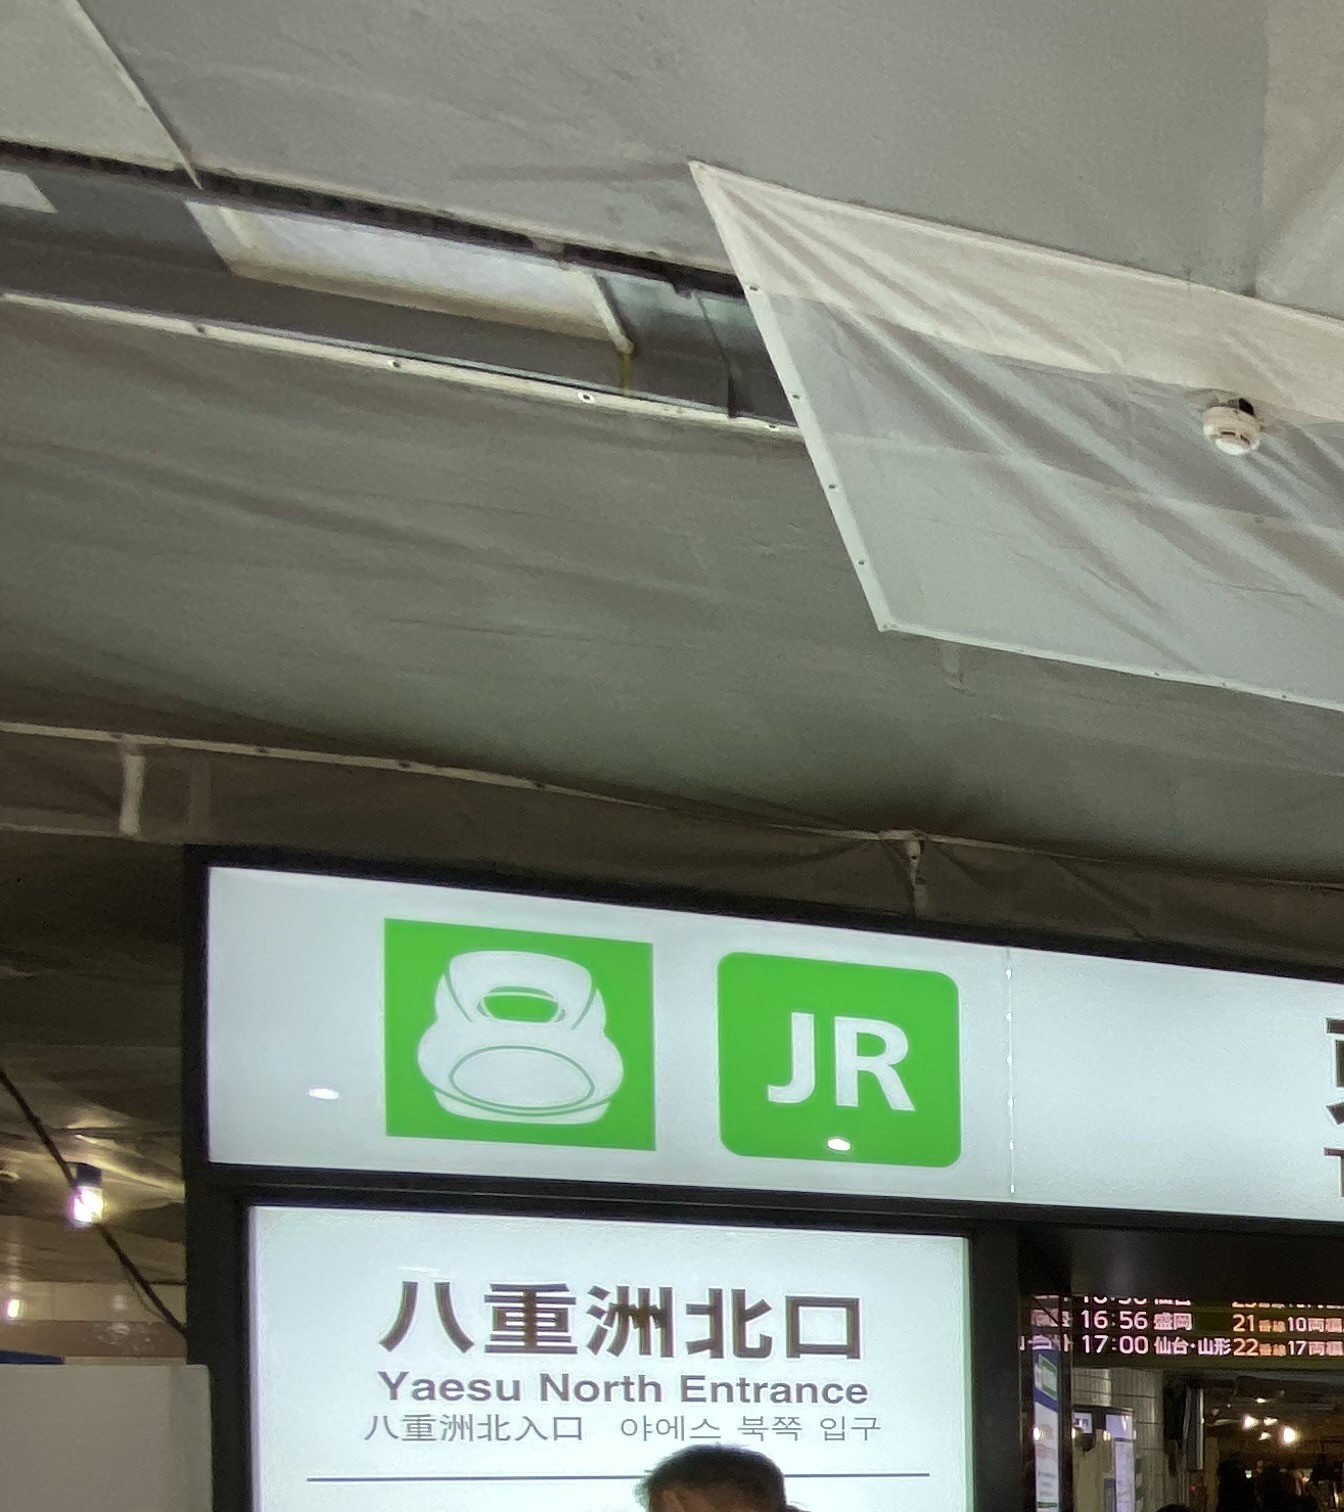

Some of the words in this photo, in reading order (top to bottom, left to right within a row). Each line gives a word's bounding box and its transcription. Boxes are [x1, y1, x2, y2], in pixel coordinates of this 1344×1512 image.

[767, 1012, 916, 1112] JR
[378, 1279, 864, 1362] 八重洲北口
[1081, 1309, 1149, 1330] 16:56
[1153, 1312, 1193, 1331] 盛岡
[1081, 1334, 1149, 1355] 17:00
[1153, 1336, 1232, 1356] 仙台・山形
[377, 1370, 522, 1404] Yaesu
[538, 1372, 663, 1404] North
[680, 1374, 869, 1406] Entrance
[363, 1413, 584, 1442] 八重洲北入口
[618, 1414, 722, 1442] 야에스
[737, 1414, 803, 1442] 북쪽
[818, 1414, 882, 1442] 입구
